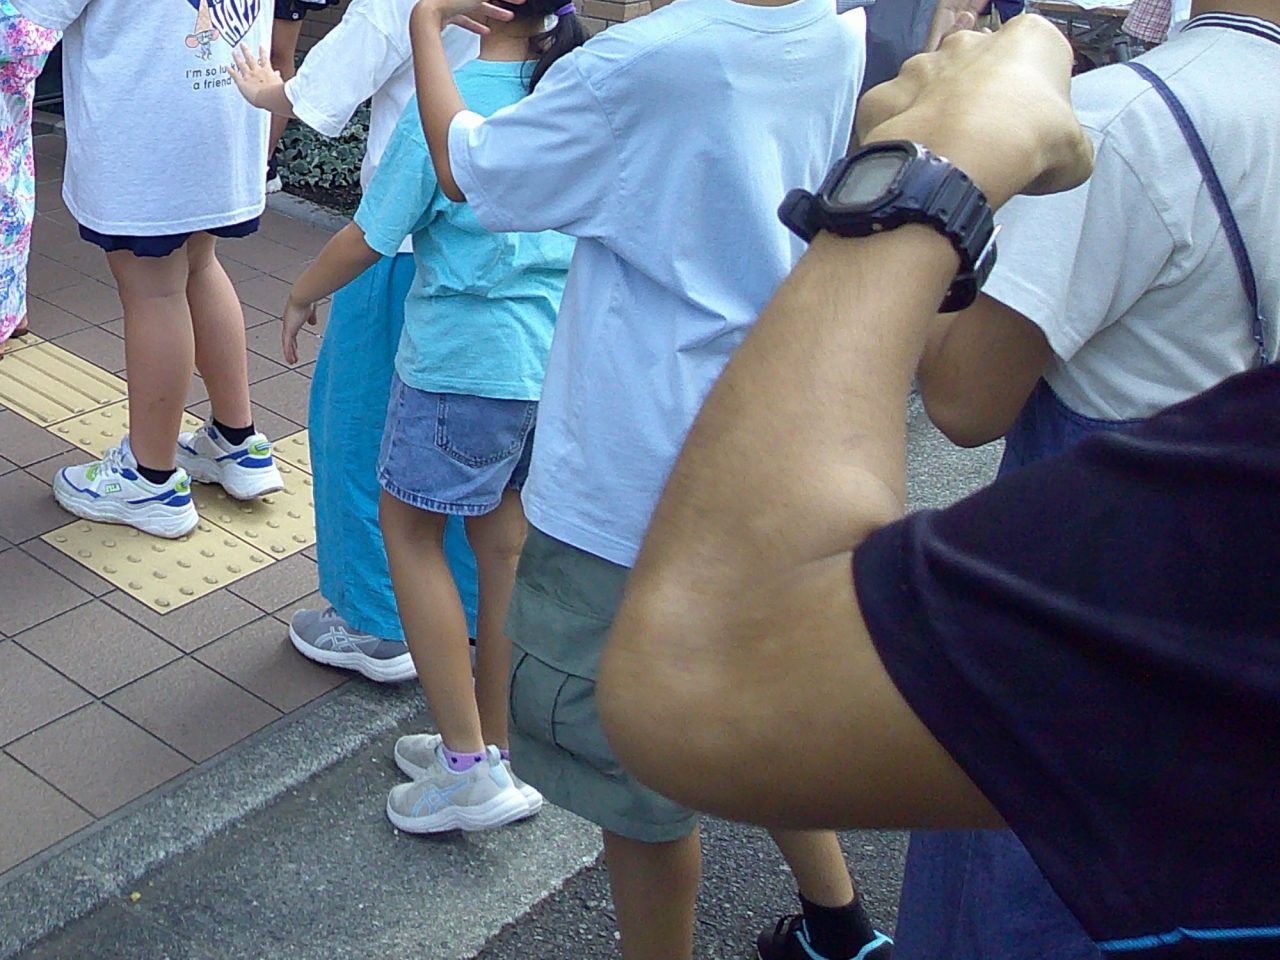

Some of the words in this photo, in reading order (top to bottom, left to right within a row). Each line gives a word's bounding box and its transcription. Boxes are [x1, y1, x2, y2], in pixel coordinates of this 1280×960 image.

[186, 69, 202, 79] I'm
[205, 68, 217, 77] so
[219, 63, 240, 75] luky
[193, 82, 200, 90] a
[204, 76, 232, 89] friend
